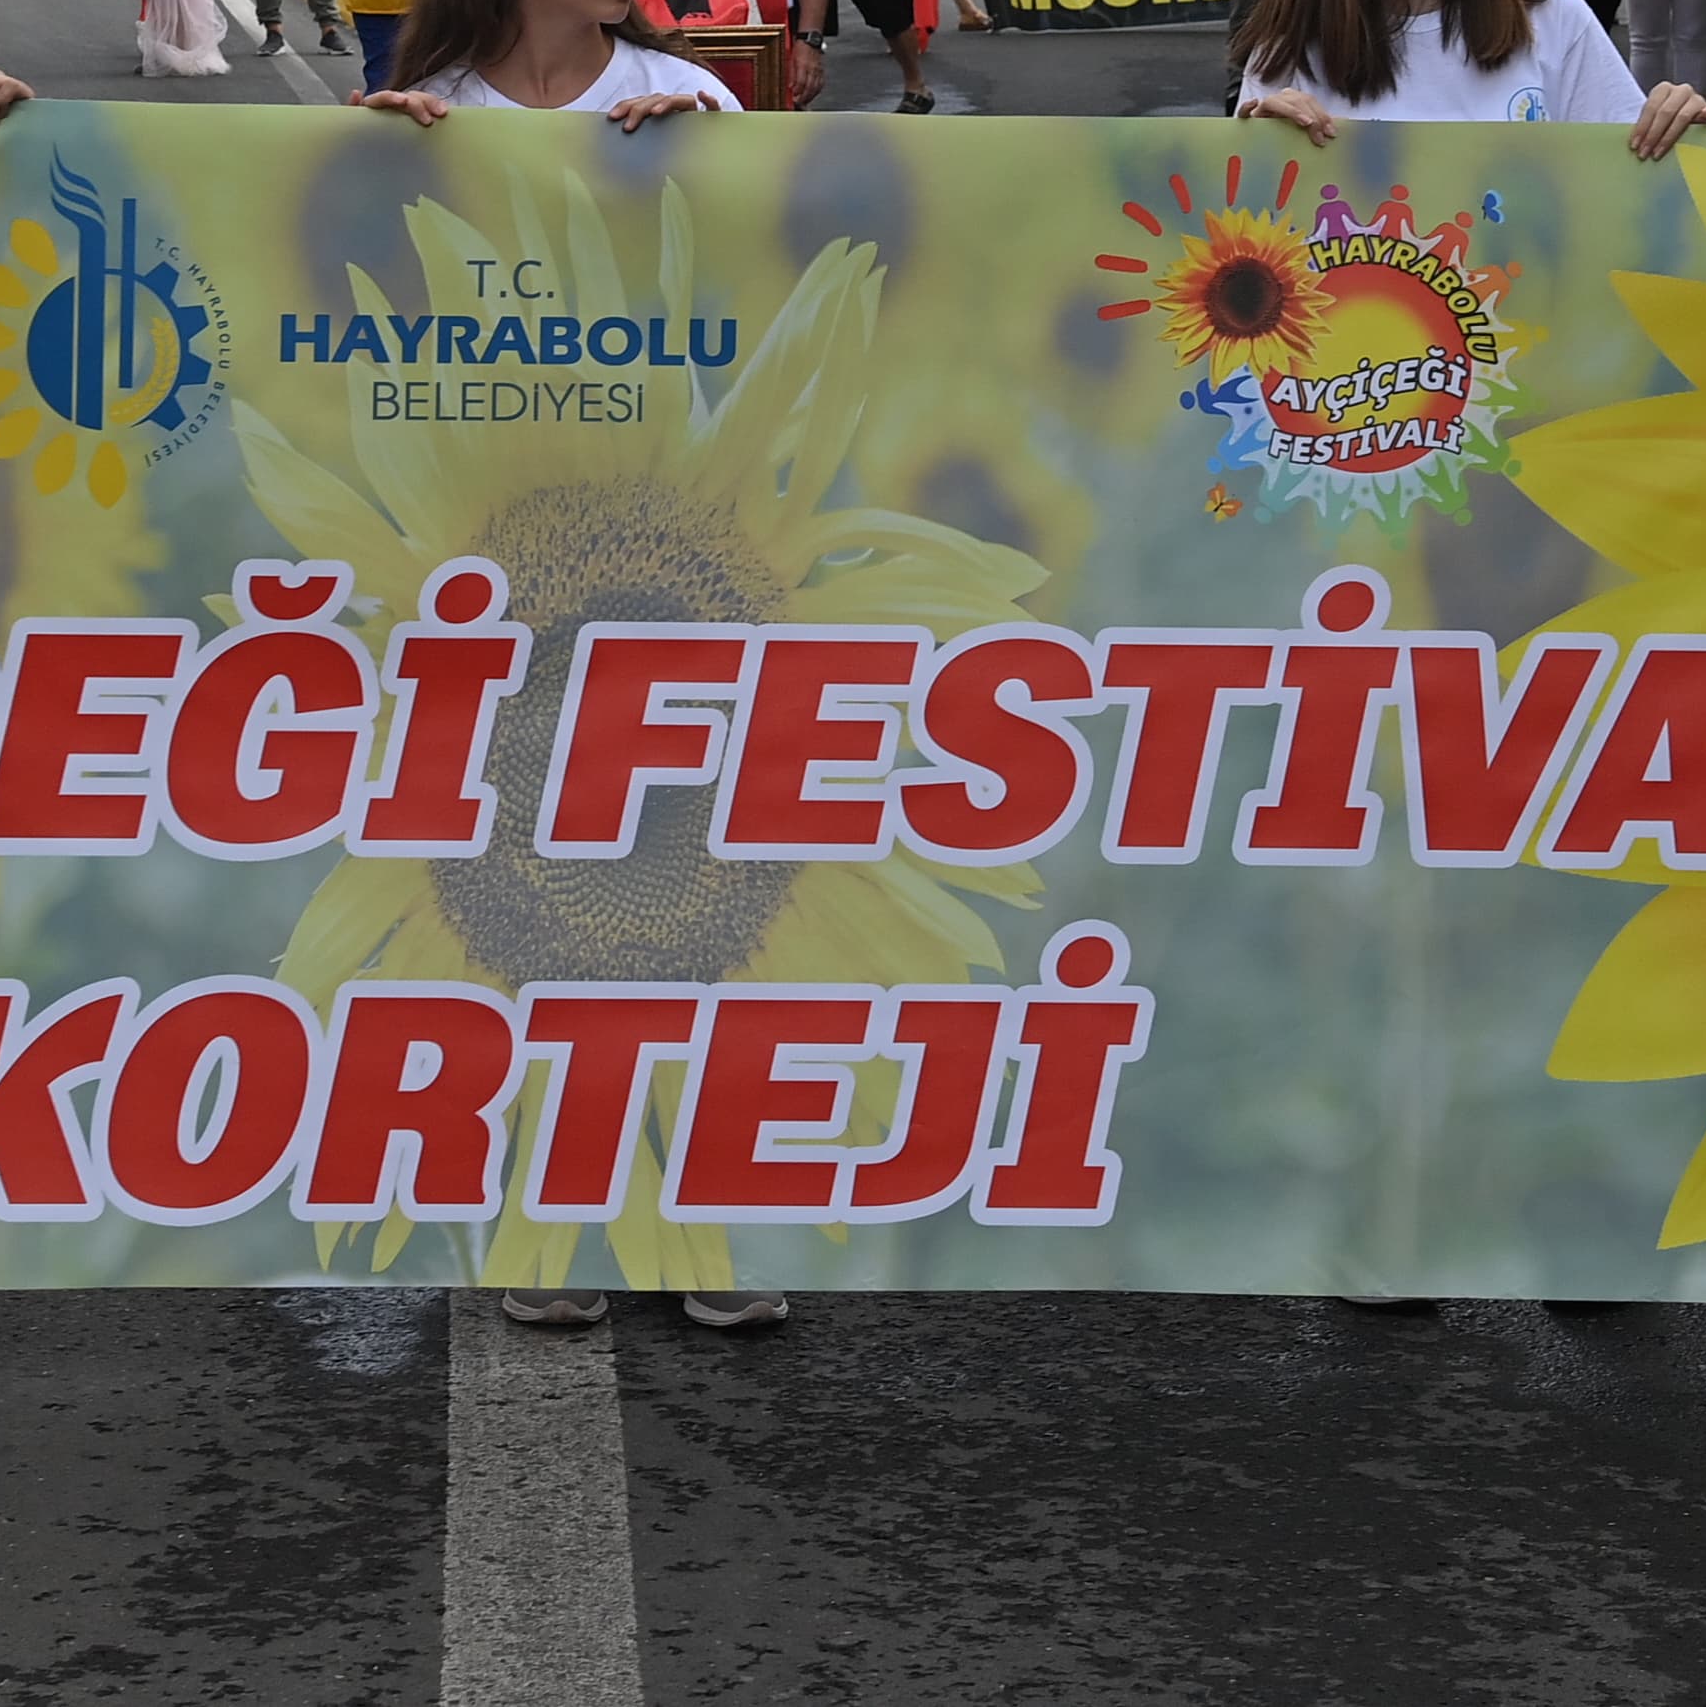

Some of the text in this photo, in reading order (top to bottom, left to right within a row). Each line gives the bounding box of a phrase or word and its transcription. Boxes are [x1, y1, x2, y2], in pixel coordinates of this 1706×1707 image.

[466, 259, 556, 299] T.C.
[1310, 235, 1498, 365] HAYRABOLU
[188, 263, 231, 371] HAYRABOLU
[278, 313, 739, 368] HAYRABOLU
[371, 381, 645, 424] BELEDİYESİ
[1270, 346, 1472, 421] AYÇİÇEĞİ
[1267, 415, 1466, 465] FESTİVALİ
